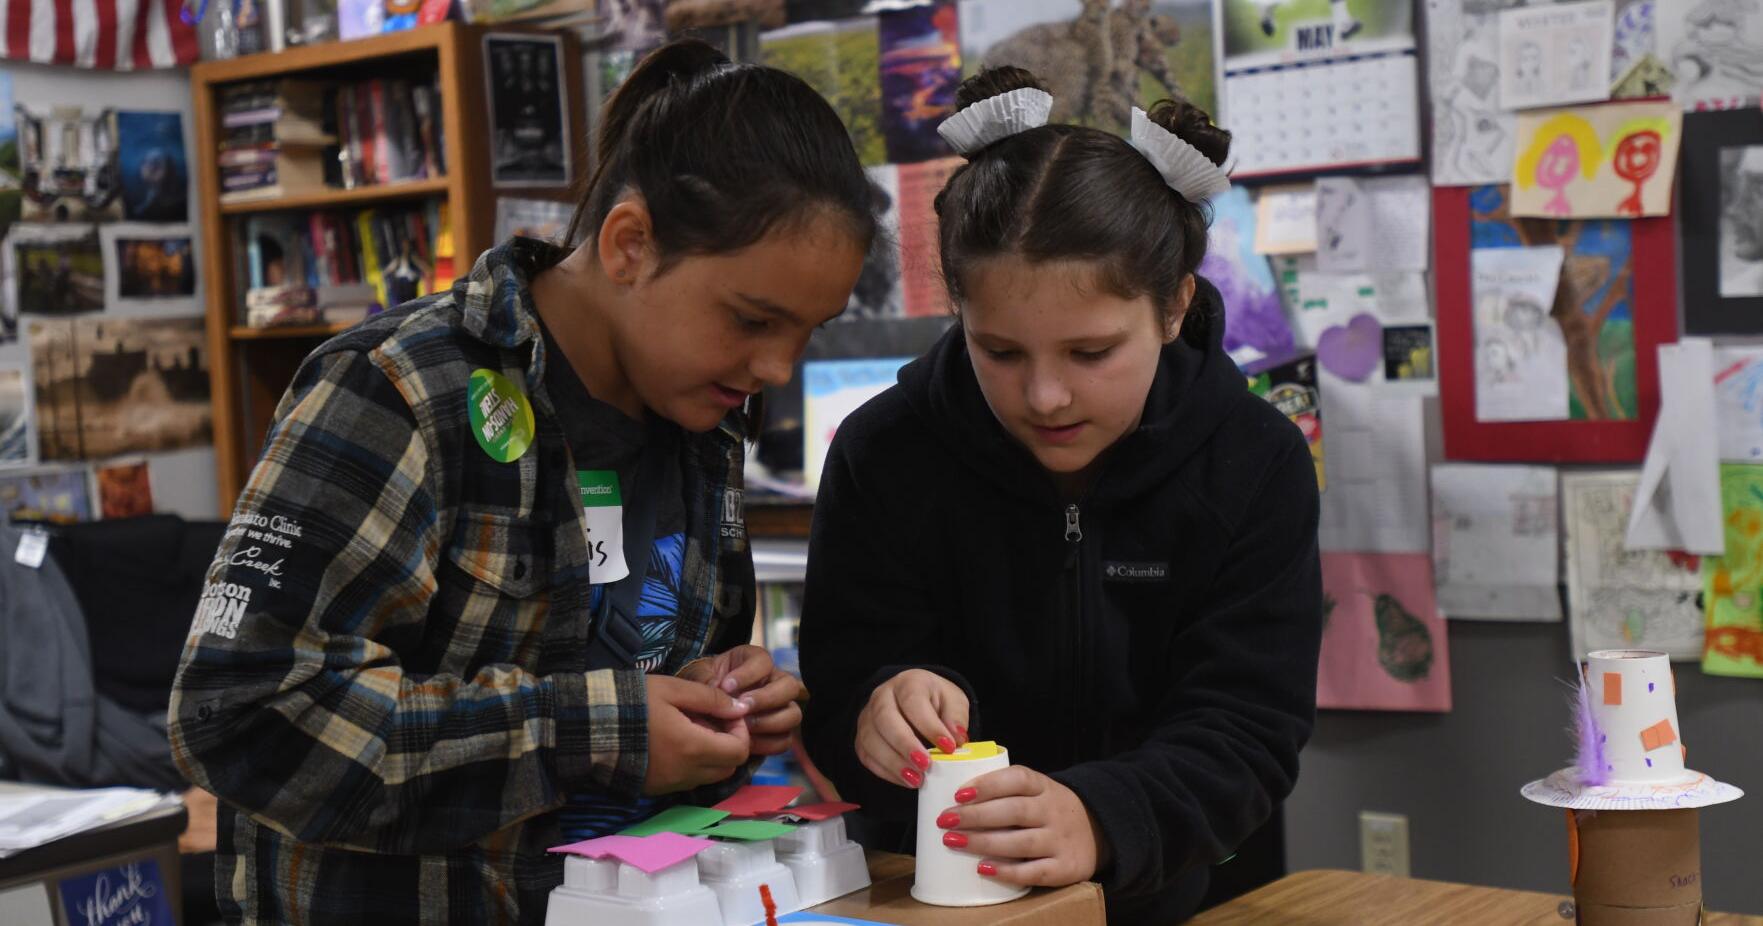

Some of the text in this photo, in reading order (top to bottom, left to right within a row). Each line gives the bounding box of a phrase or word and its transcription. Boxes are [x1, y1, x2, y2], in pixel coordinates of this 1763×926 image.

[1296, 25, 1334, 50] MAY
[247, 529, 262, 540] we
[230, 545, 285, 576] Creek
[1117, 565, 1165, 577] Columbia
